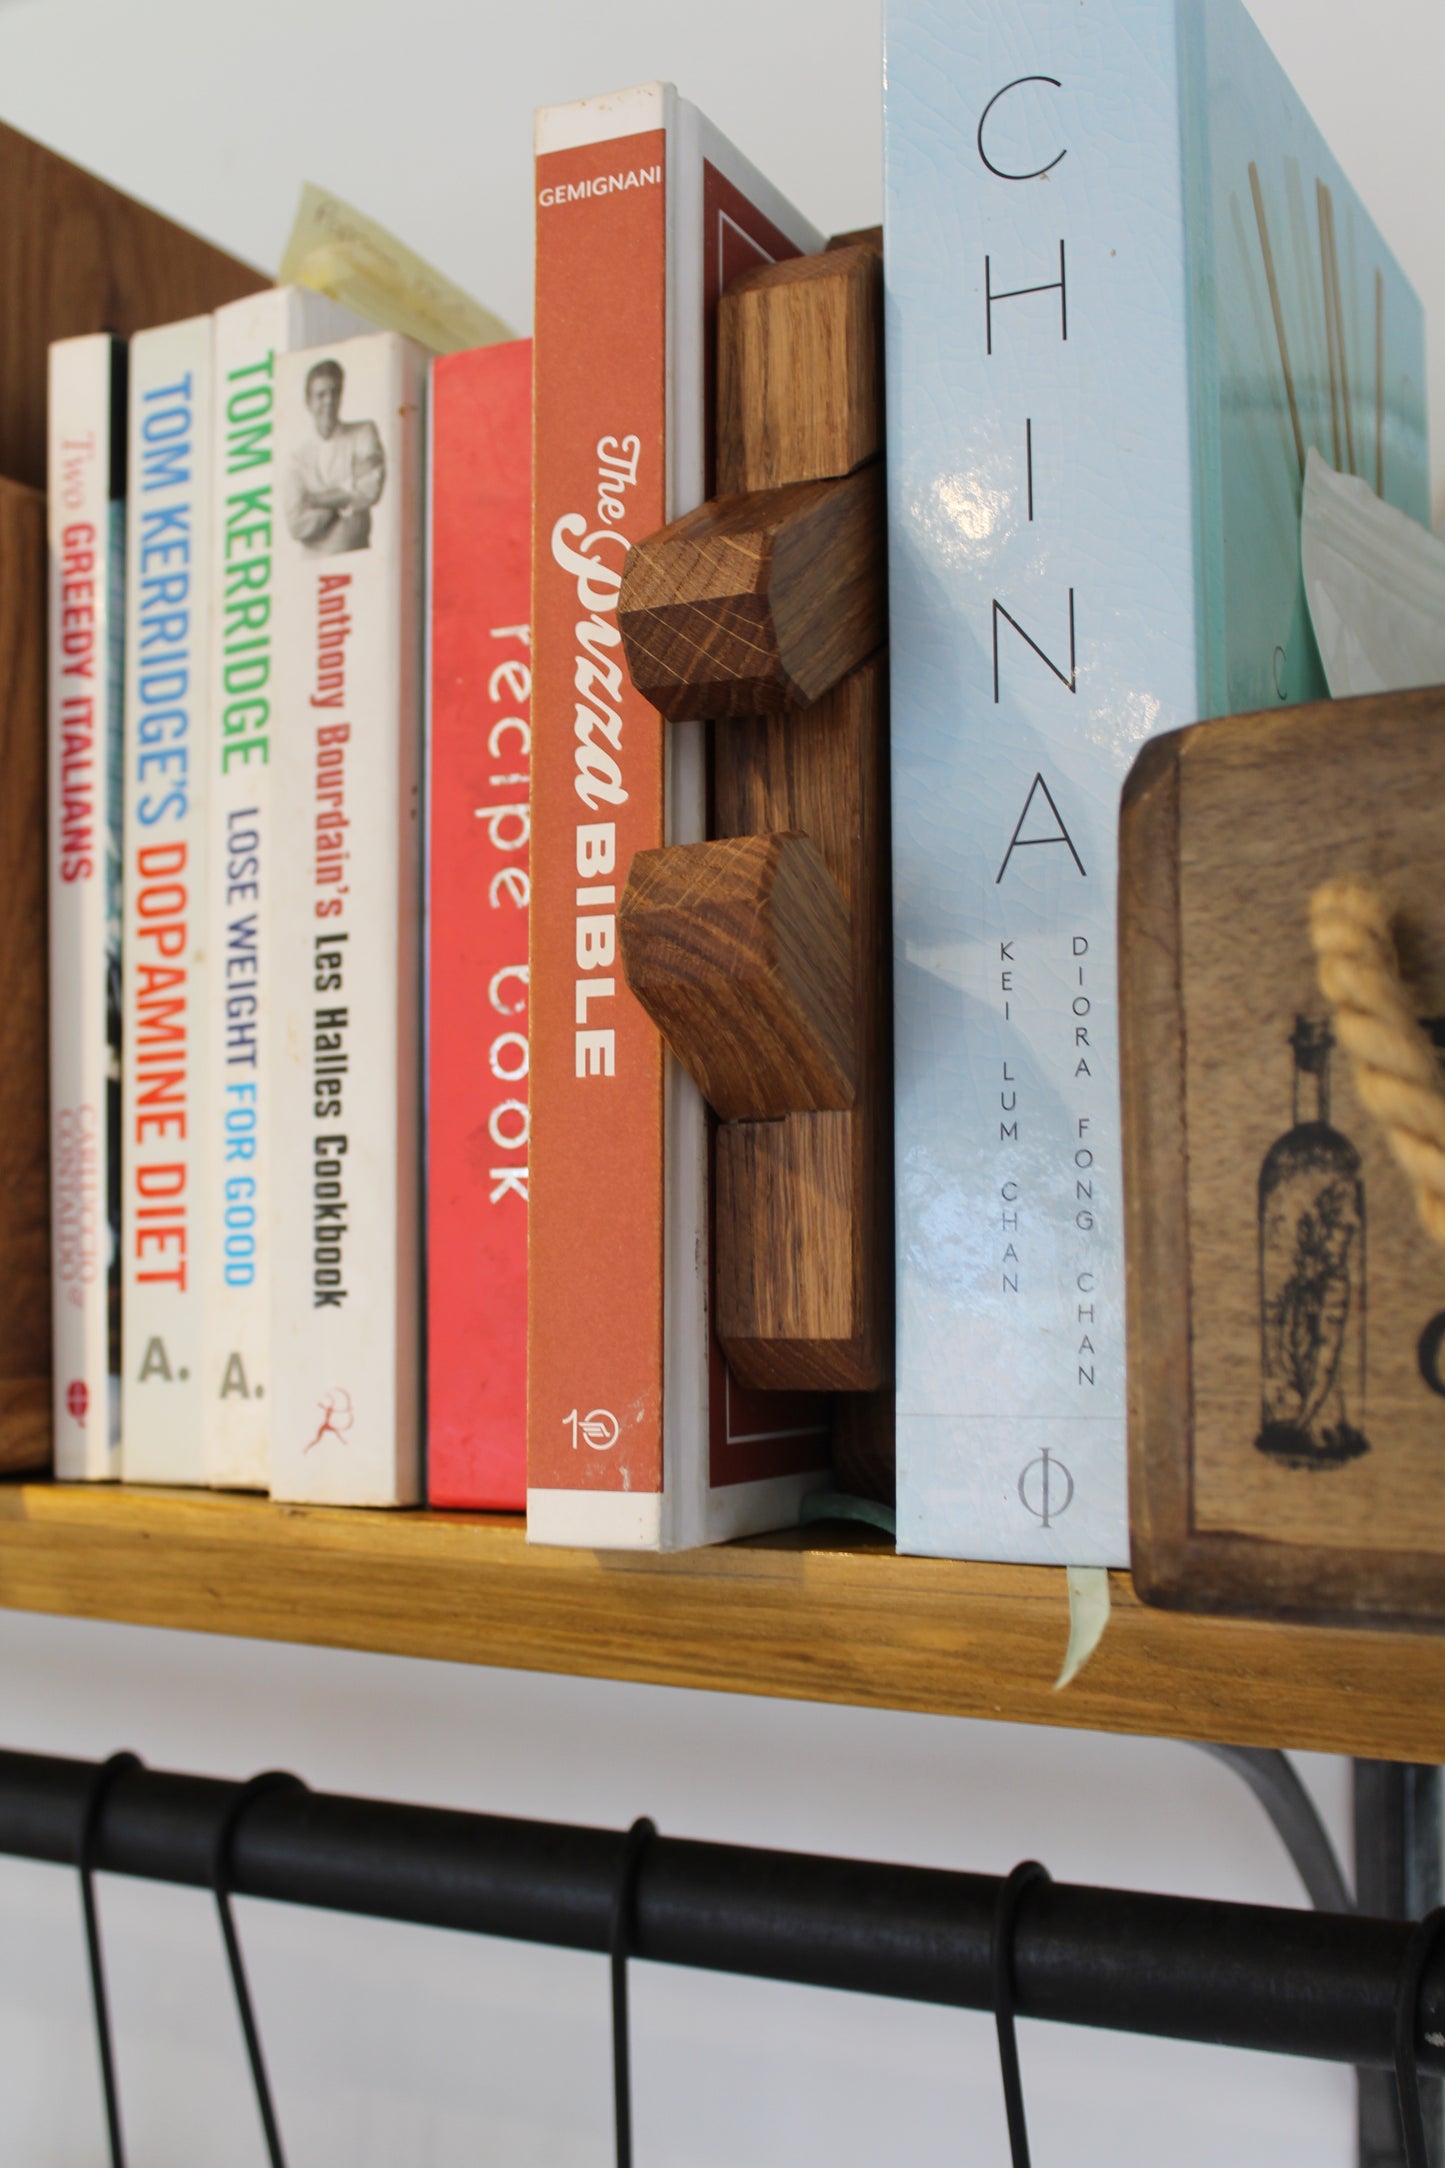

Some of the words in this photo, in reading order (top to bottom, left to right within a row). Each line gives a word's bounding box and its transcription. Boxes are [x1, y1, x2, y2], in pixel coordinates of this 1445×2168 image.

[538, 164, 662, 208] GEMIGNANI
[60, 430, 96, 510] Two
[142, 371, 193, 493] TOM
[227, 350, 274, 475] TOM
[596, 433, 642, 527] The
[977, 74, 1087, 884] CHINA
[60, 522, 96, 681] GREEDY
[222, 486, 272, 775] KERRIDGE
[310, 573, 353, 709] Anthony
[551, 512, 632, 812] Pizza
[136, 503, 191, 829] KERRIDGE'S
[59, 695, 94, 886] ITALIANS
[315, 723, 351, 919] Bourdain's
[474, 623, 531, 910] recipe
[226, 808, 260, 906] LOSE
[136, 842, 189, 1146] DOPAMINE
[225, 914, 259, 1069] WEIGHT
[314, 932, 349, 993] Les
[575, 823, 616, 1078] BIBLE
[1000, 940, 1015, 1022] KEI
[1070, 935, 1093, 1079] DIORA
[225, 1083, 257, 1163] FOR
[313, 1007, 349, 1120] Halles
[1000, 1061, 1019, 1142] LUM
[135, 1163, 188, 1293] DIET
[223, 1177, 257, 1290] GOOD
[313, 1134, 349, 1309] Cookbook
[1000, 1182, 1020, 1294] CHAN
[1074, 1118, 1095, 1232] FONG
[1076, 1271, 1096, 1387] CHAN
